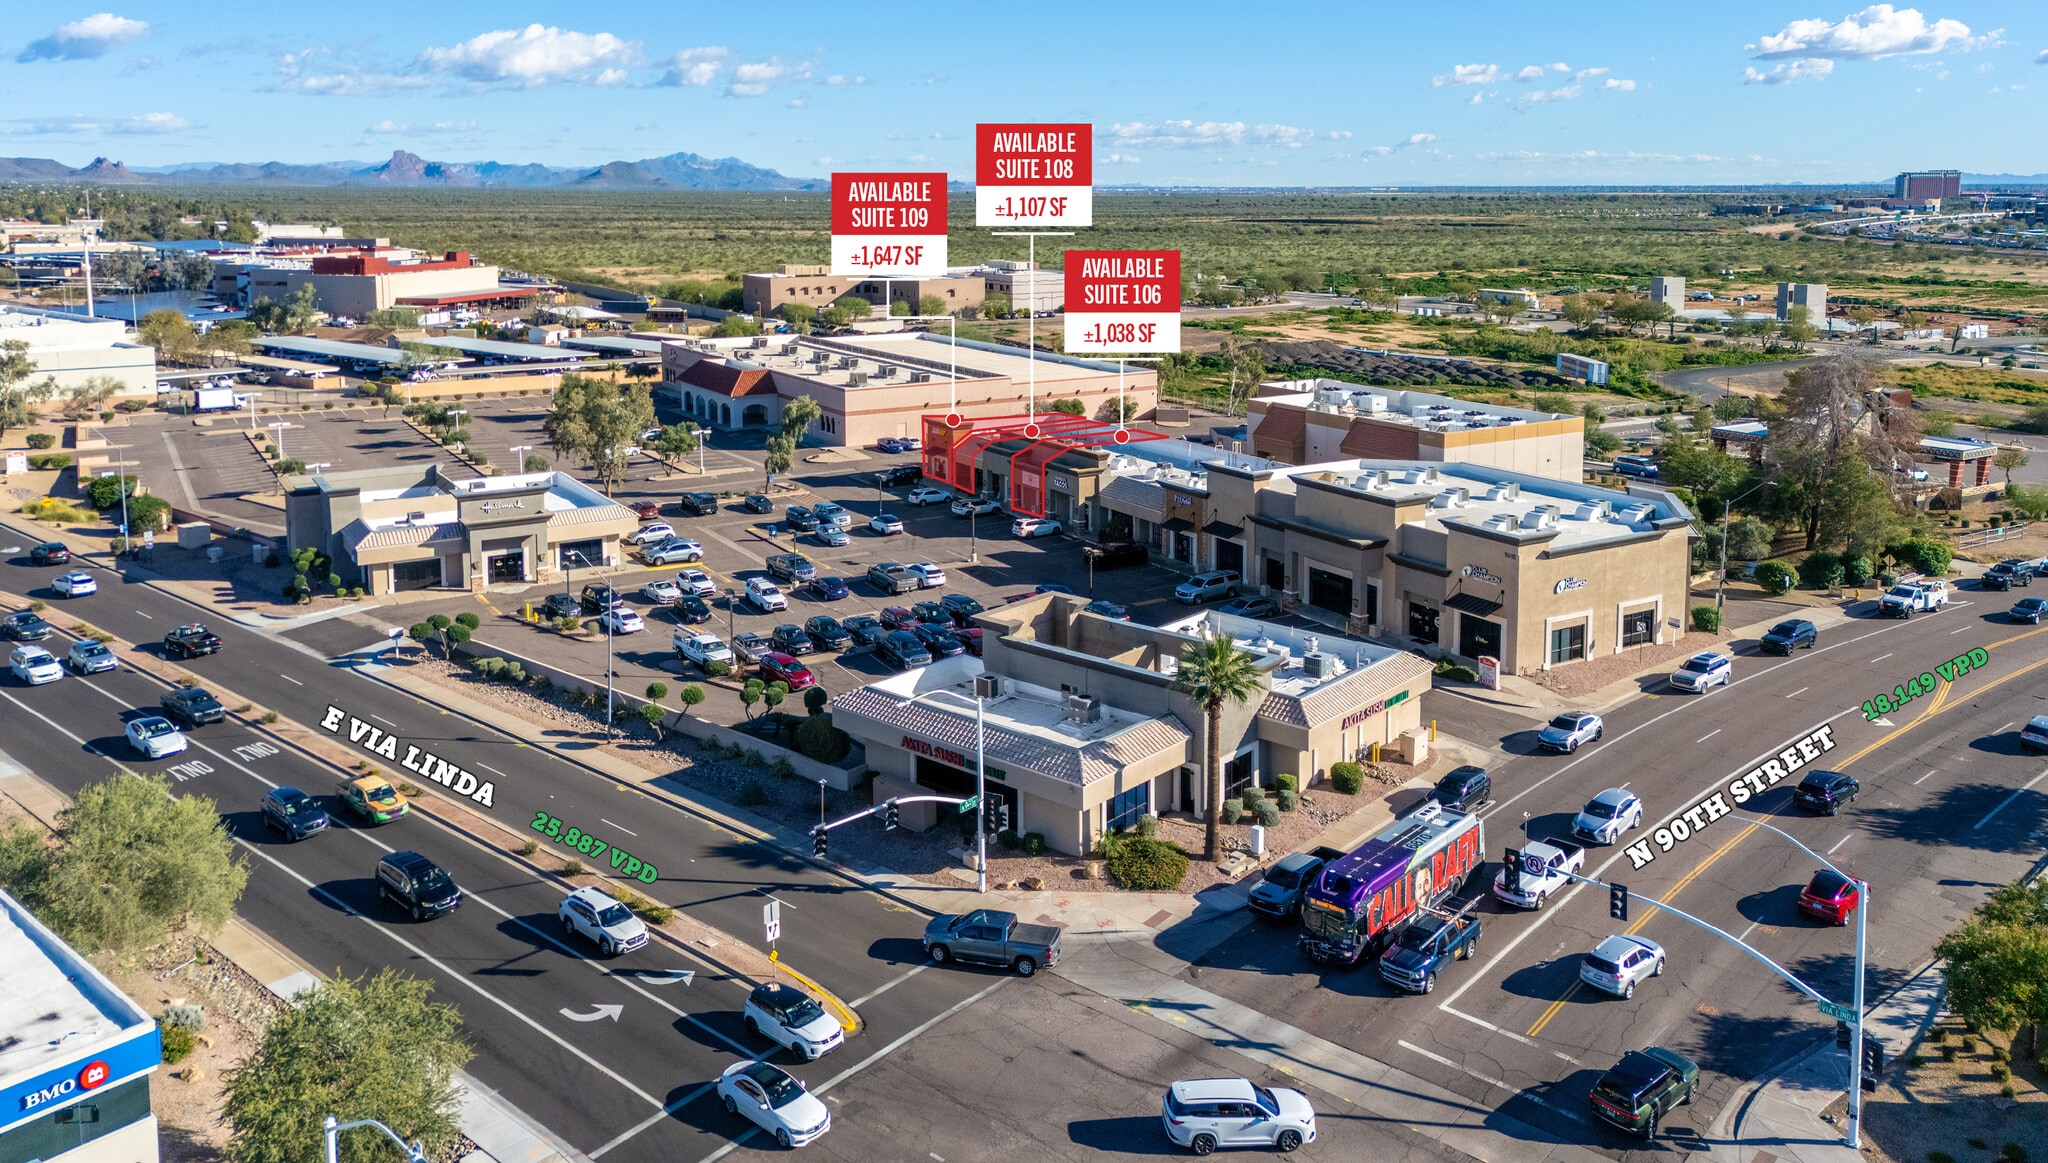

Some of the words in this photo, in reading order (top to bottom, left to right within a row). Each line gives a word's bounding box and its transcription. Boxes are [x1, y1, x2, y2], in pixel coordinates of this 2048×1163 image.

[480, 499, 525, 515] Hallmark
[1471, 564, 1488, 575] CLUB
[1471, 570, 1502, 584] CHAMPION
[1565, 579, 1588, 589] CHAMPION
[1341, 709, 1365, 731] AKITA
[1363, 700, 1385, 720] SUSHI
[231, 742, 280, 762] ONLY
[901, 735, 933, 757] AKITA
[933, 746, 965, 768] SUSHI
[166, 760, 215, 782] ONLY
[1405, 834, 1433, 851] 6870
[1367, 871, 1417, 938] CALL
[1431, 825, 1480, 898] RAFI!
[1821, 1005, 1833, 1015] VIA
[1835, 1010, 1857, 1022] LINDA
[24, 1078, 77, 1109] BMO
